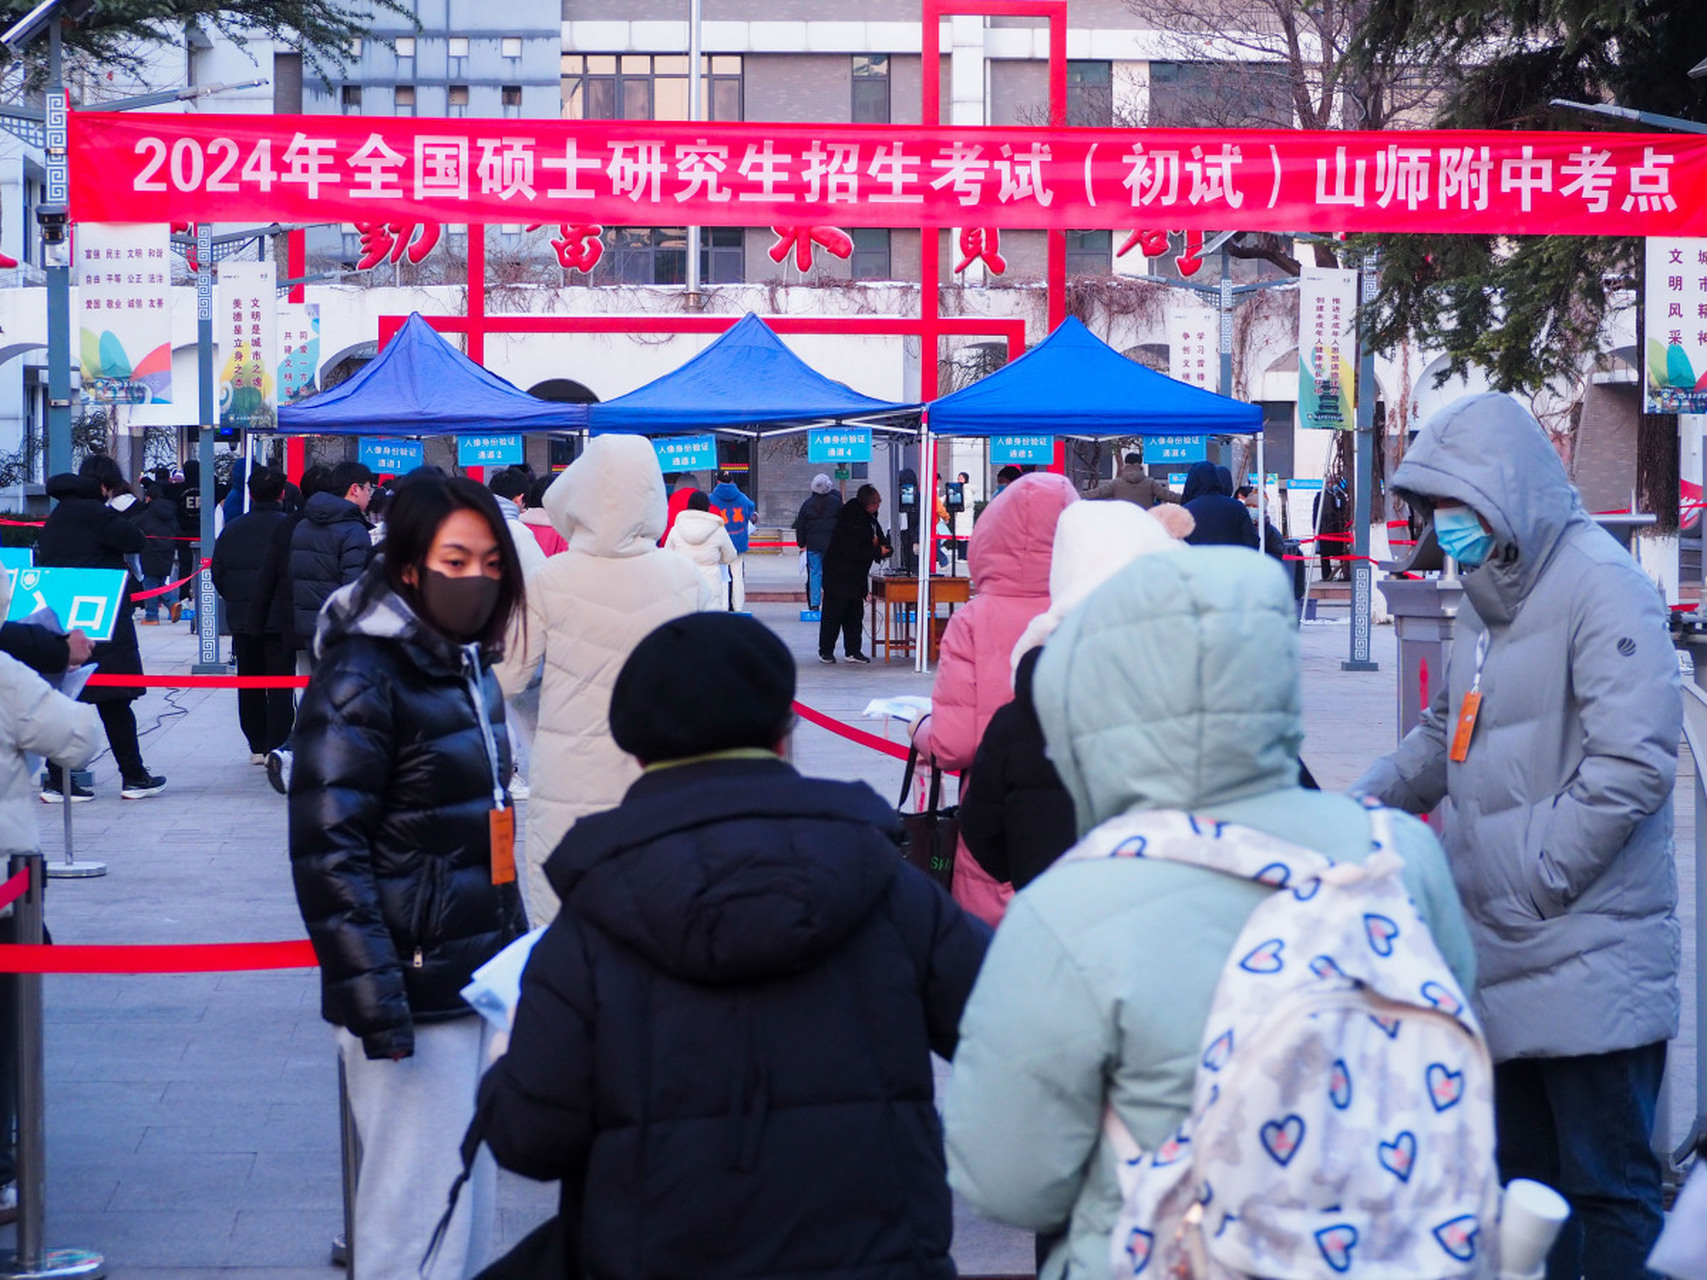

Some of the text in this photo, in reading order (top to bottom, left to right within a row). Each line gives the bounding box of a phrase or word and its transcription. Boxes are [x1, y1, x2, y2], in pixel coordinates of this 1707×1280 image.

[85, 248, 164, 260] 富强 民主 文明 和谐
[85, 273, 164, 285] 自由 平等 公正 法治
[1668, 248, 1683, 346] 文明风采
[85, 298, 164, 310] 爱国 敬业 诚信 友善
[232, 298, 244, 388] 美德是立身之本
[251, 298, 262, 388] 文明是城市之魂
[1197, 332, 1205, 389] 学习雷锋
[464, 437, 515, 447] 人像身份验证
[814, 435, 866, 444] 人像身份验证
[997, 436, 1047, 446] 人像身份验证
[1150, 436, 1200, 445] 人像身份验证
[366, 446, 417, 457] 人像身份验证
[658, 442, 709, 455] 人像身份验证
